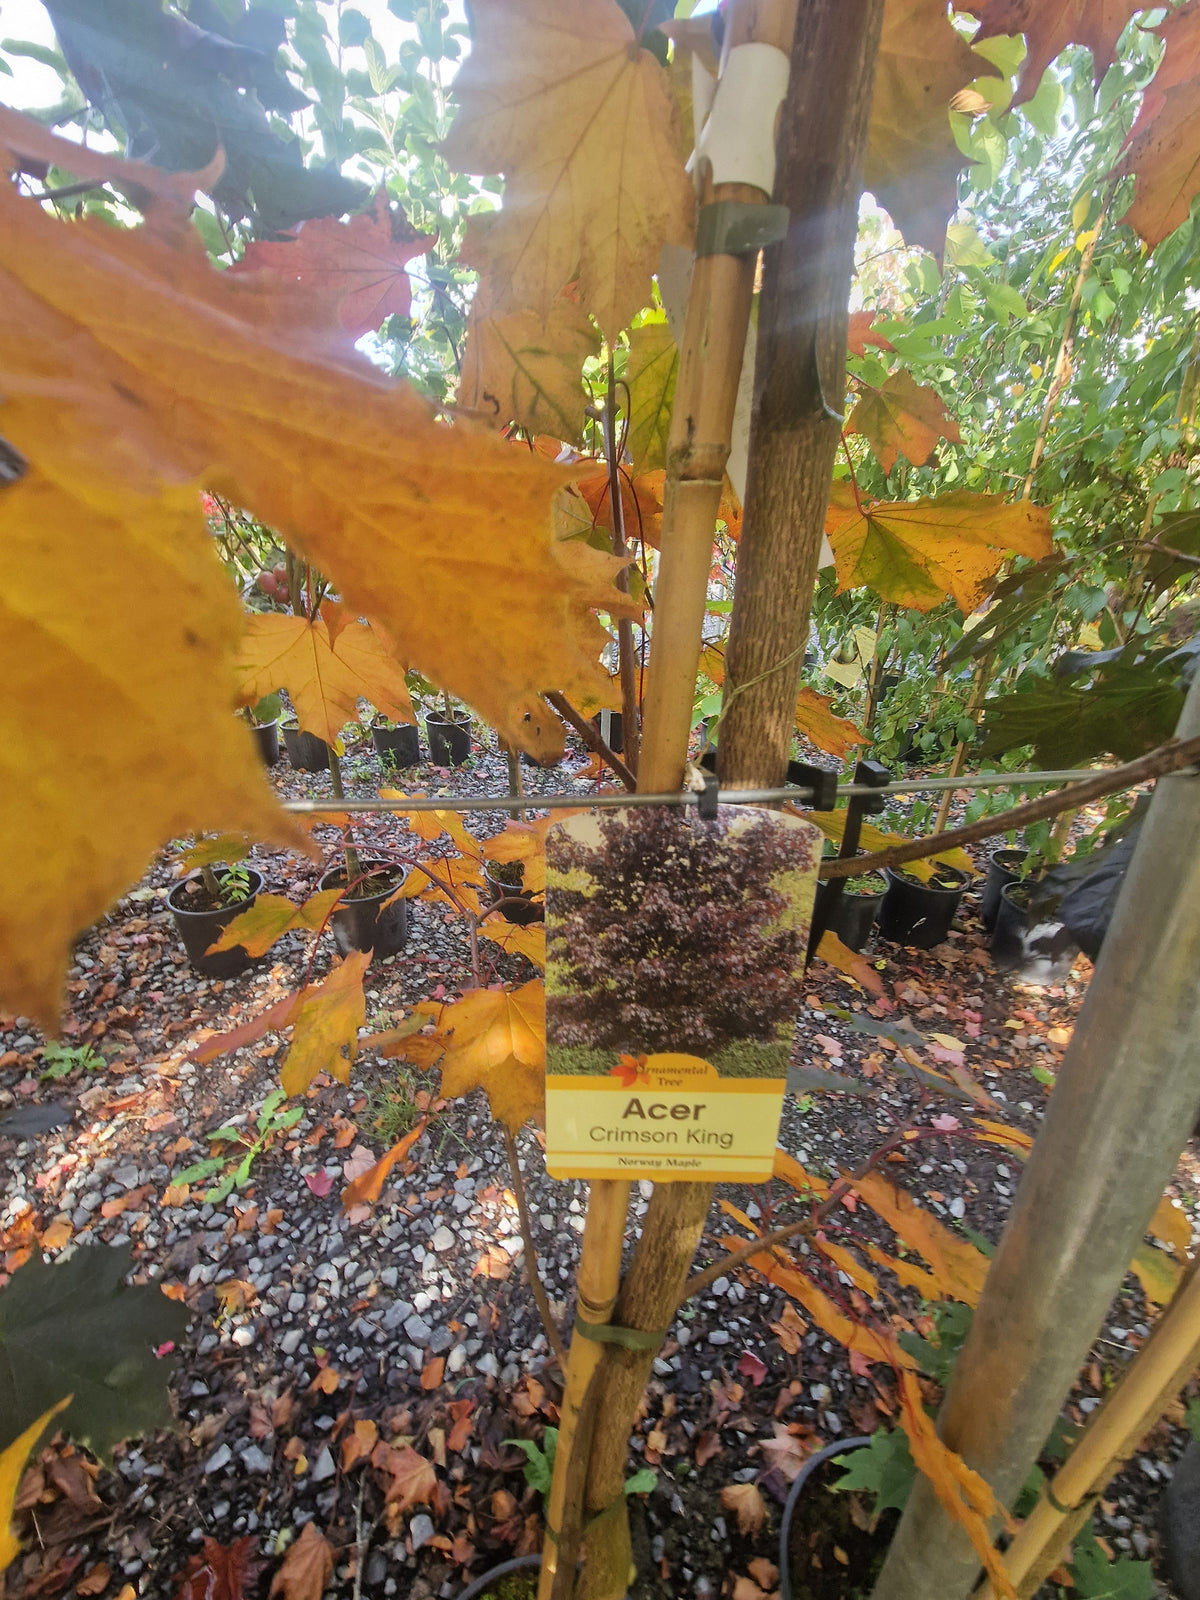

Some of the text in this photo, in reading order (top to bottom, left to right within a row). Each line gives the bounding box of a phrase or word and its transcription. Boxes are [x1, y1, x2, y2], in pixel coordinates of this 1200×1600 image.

[657, 1077, 684, 1087] Tree
[621, 1098, 707, 1121] Acer
[589, 1126, 733, 1150] Crimson King
[617, 1157, 702, 1169] Norway Maple
